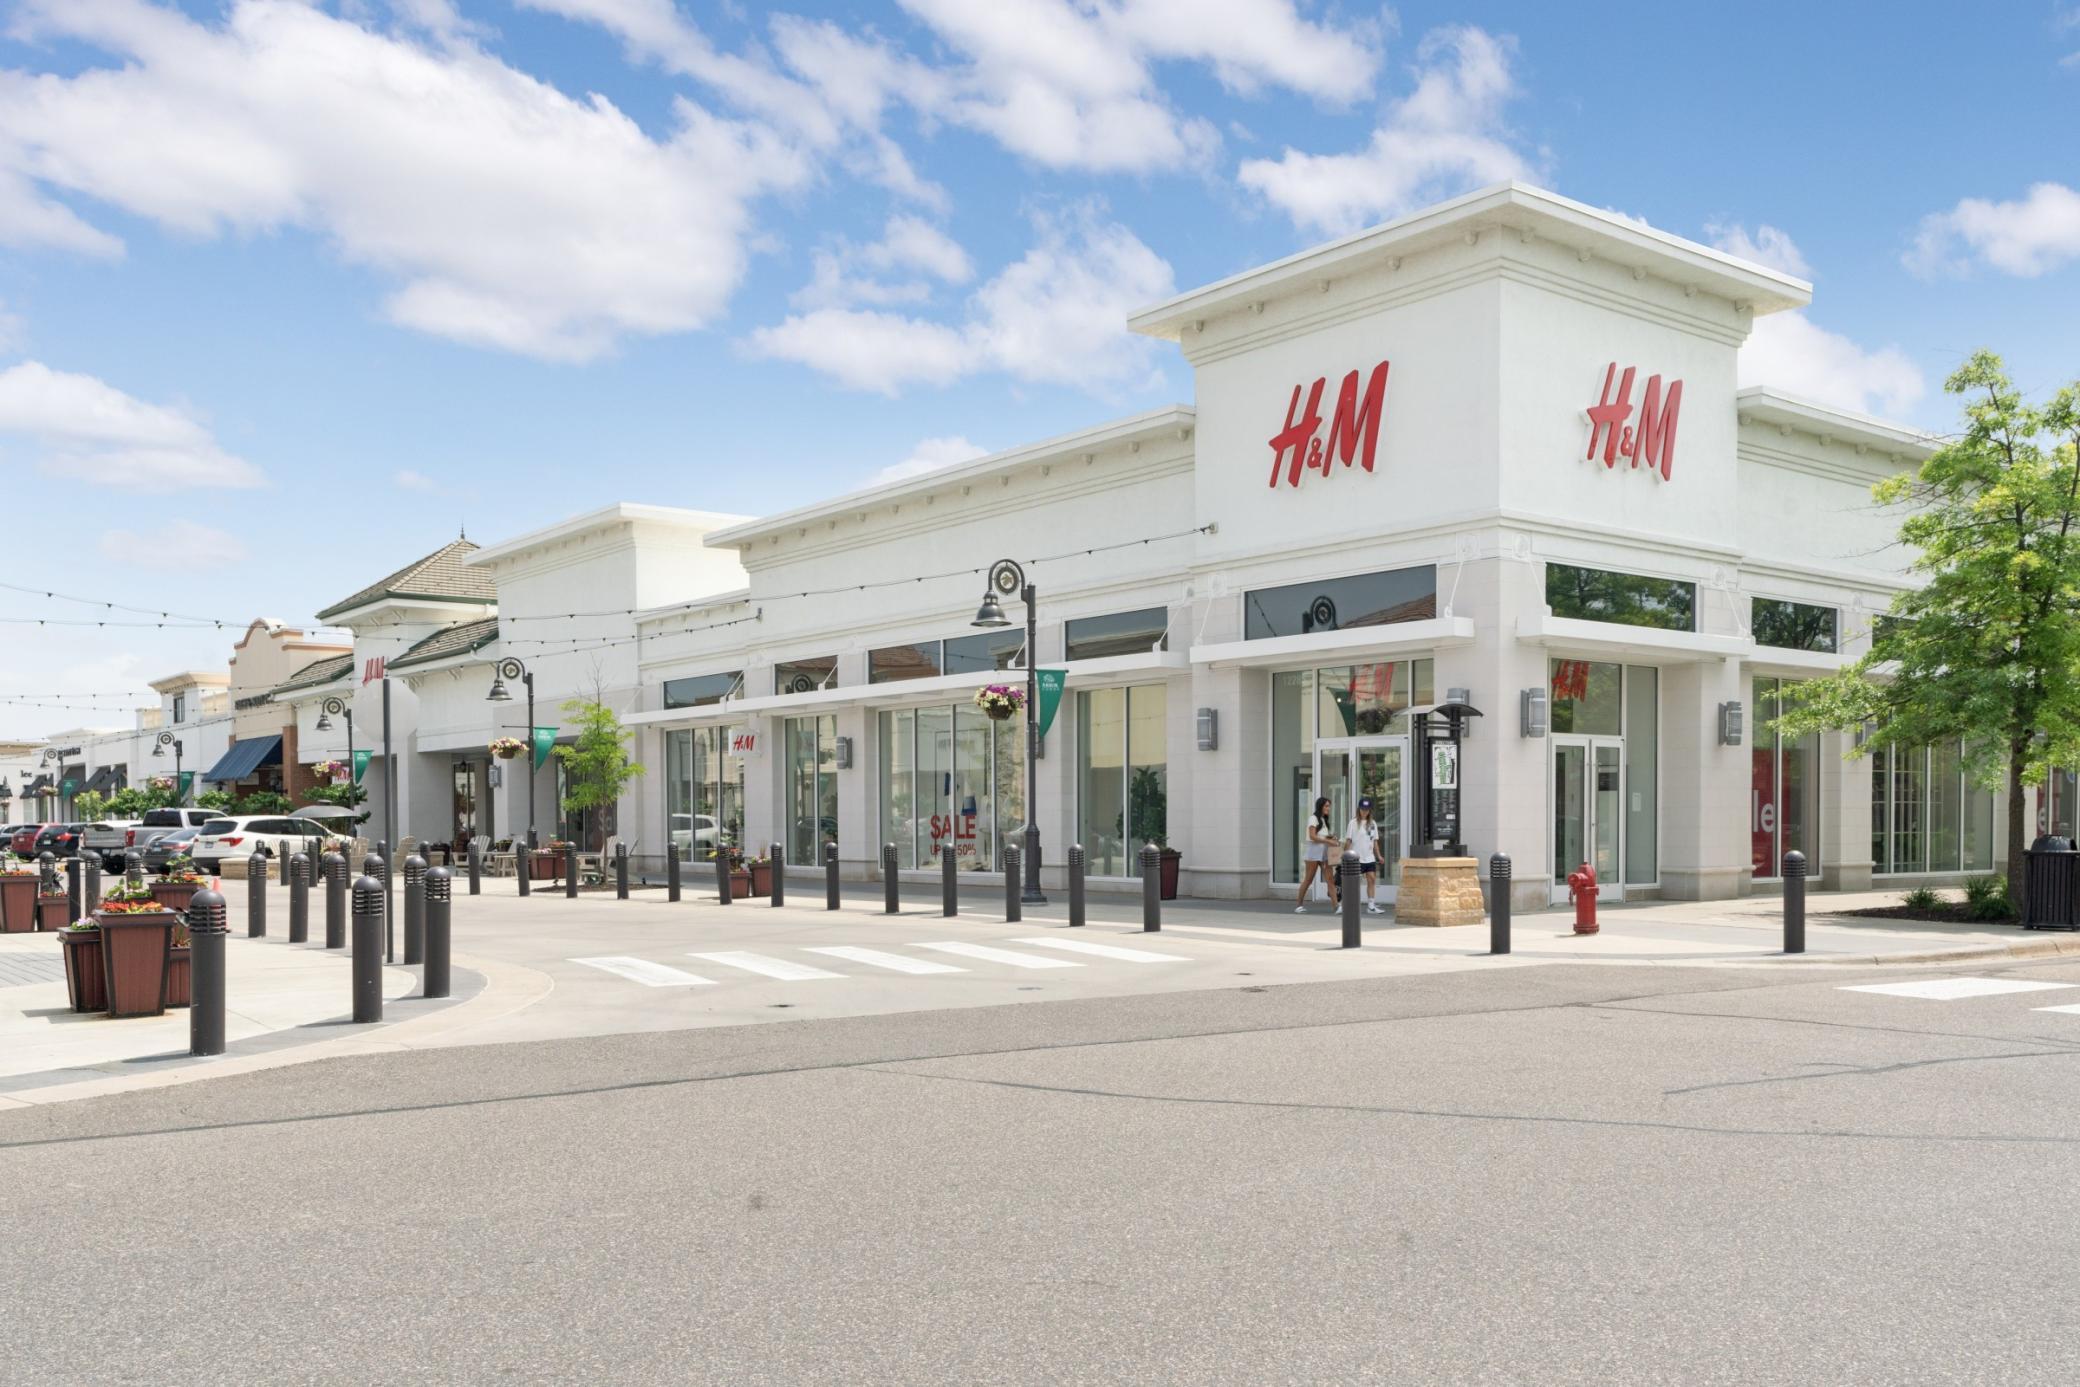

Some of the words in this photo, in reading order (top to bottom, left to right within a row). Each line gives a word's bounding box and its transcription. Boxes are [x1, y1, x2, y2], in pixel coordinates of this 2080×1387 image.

[1269, 360, 1389, 488] H&M
[1587, 361, 1682, 481] H&M
[930, 815, 976, 839] SALE
